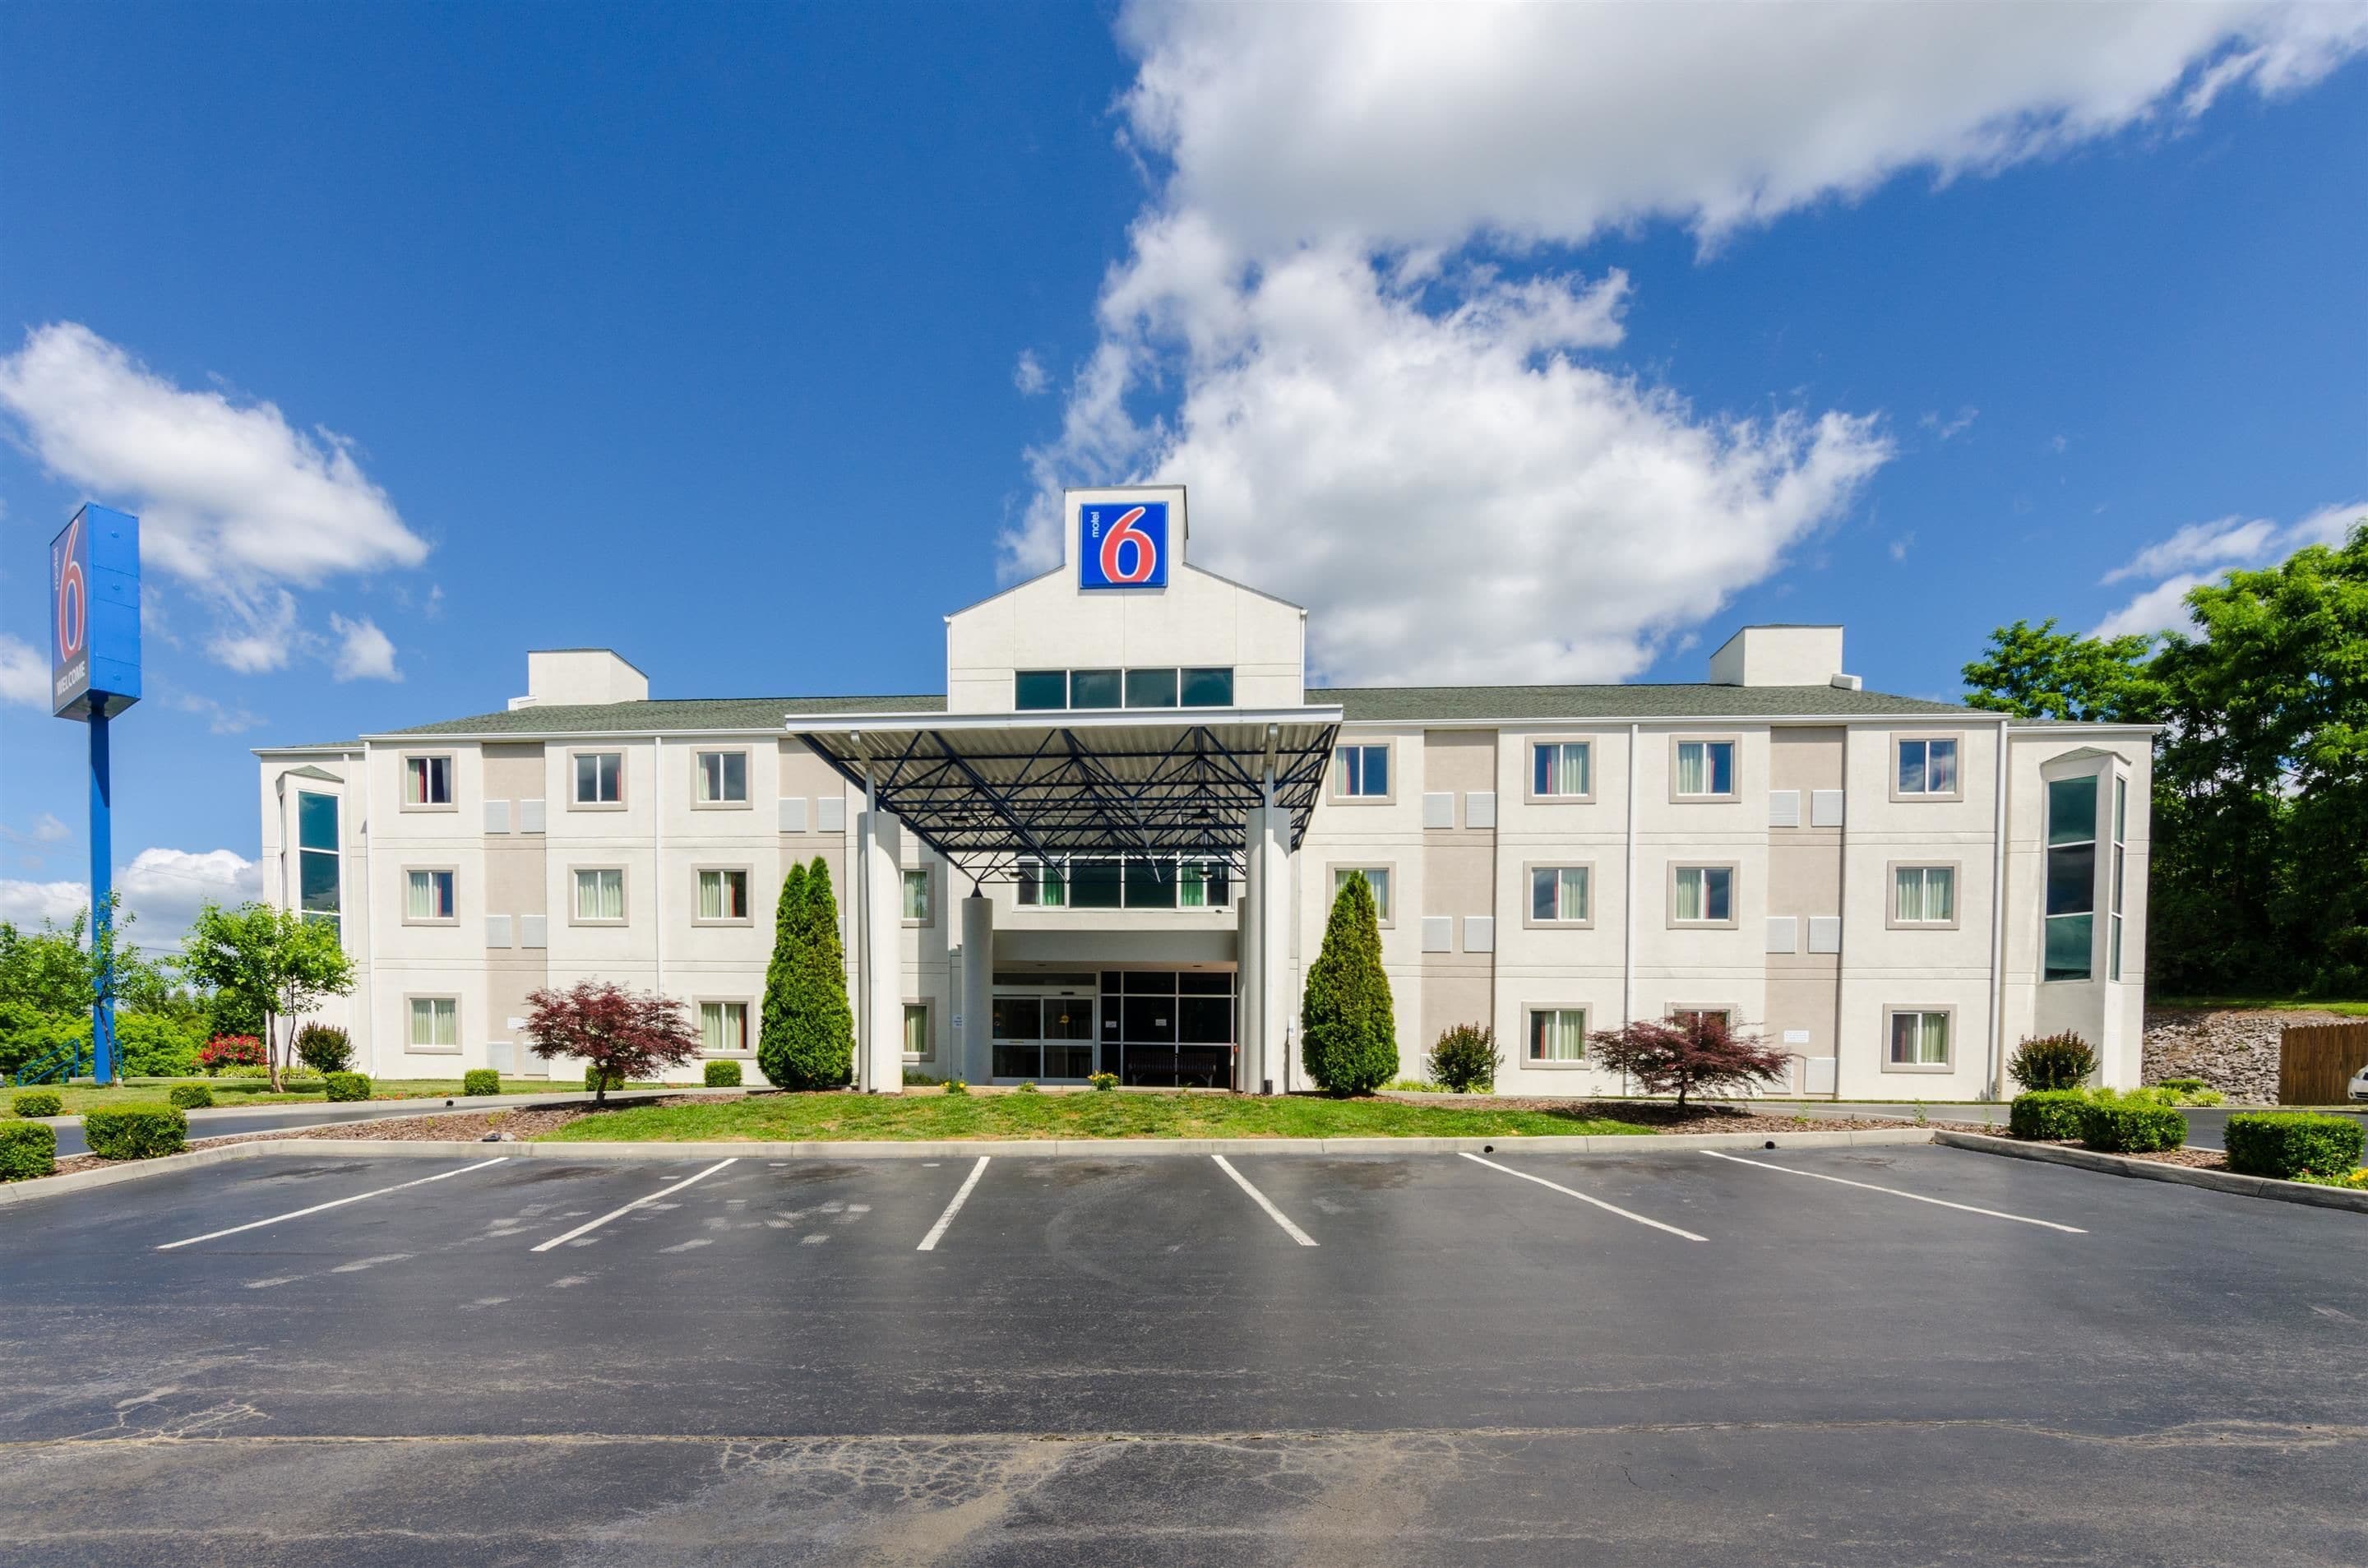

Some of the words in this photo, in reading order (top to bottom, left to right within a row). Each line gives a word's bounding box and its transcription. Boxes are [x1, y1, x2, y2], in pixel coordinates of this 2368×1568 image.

[1091, 511, 1099, 538] motel
[1100, 506, 1156, 583] 6
[59, 519, 85, 662] 6
[57, 661, 86, 696] WELCOME
